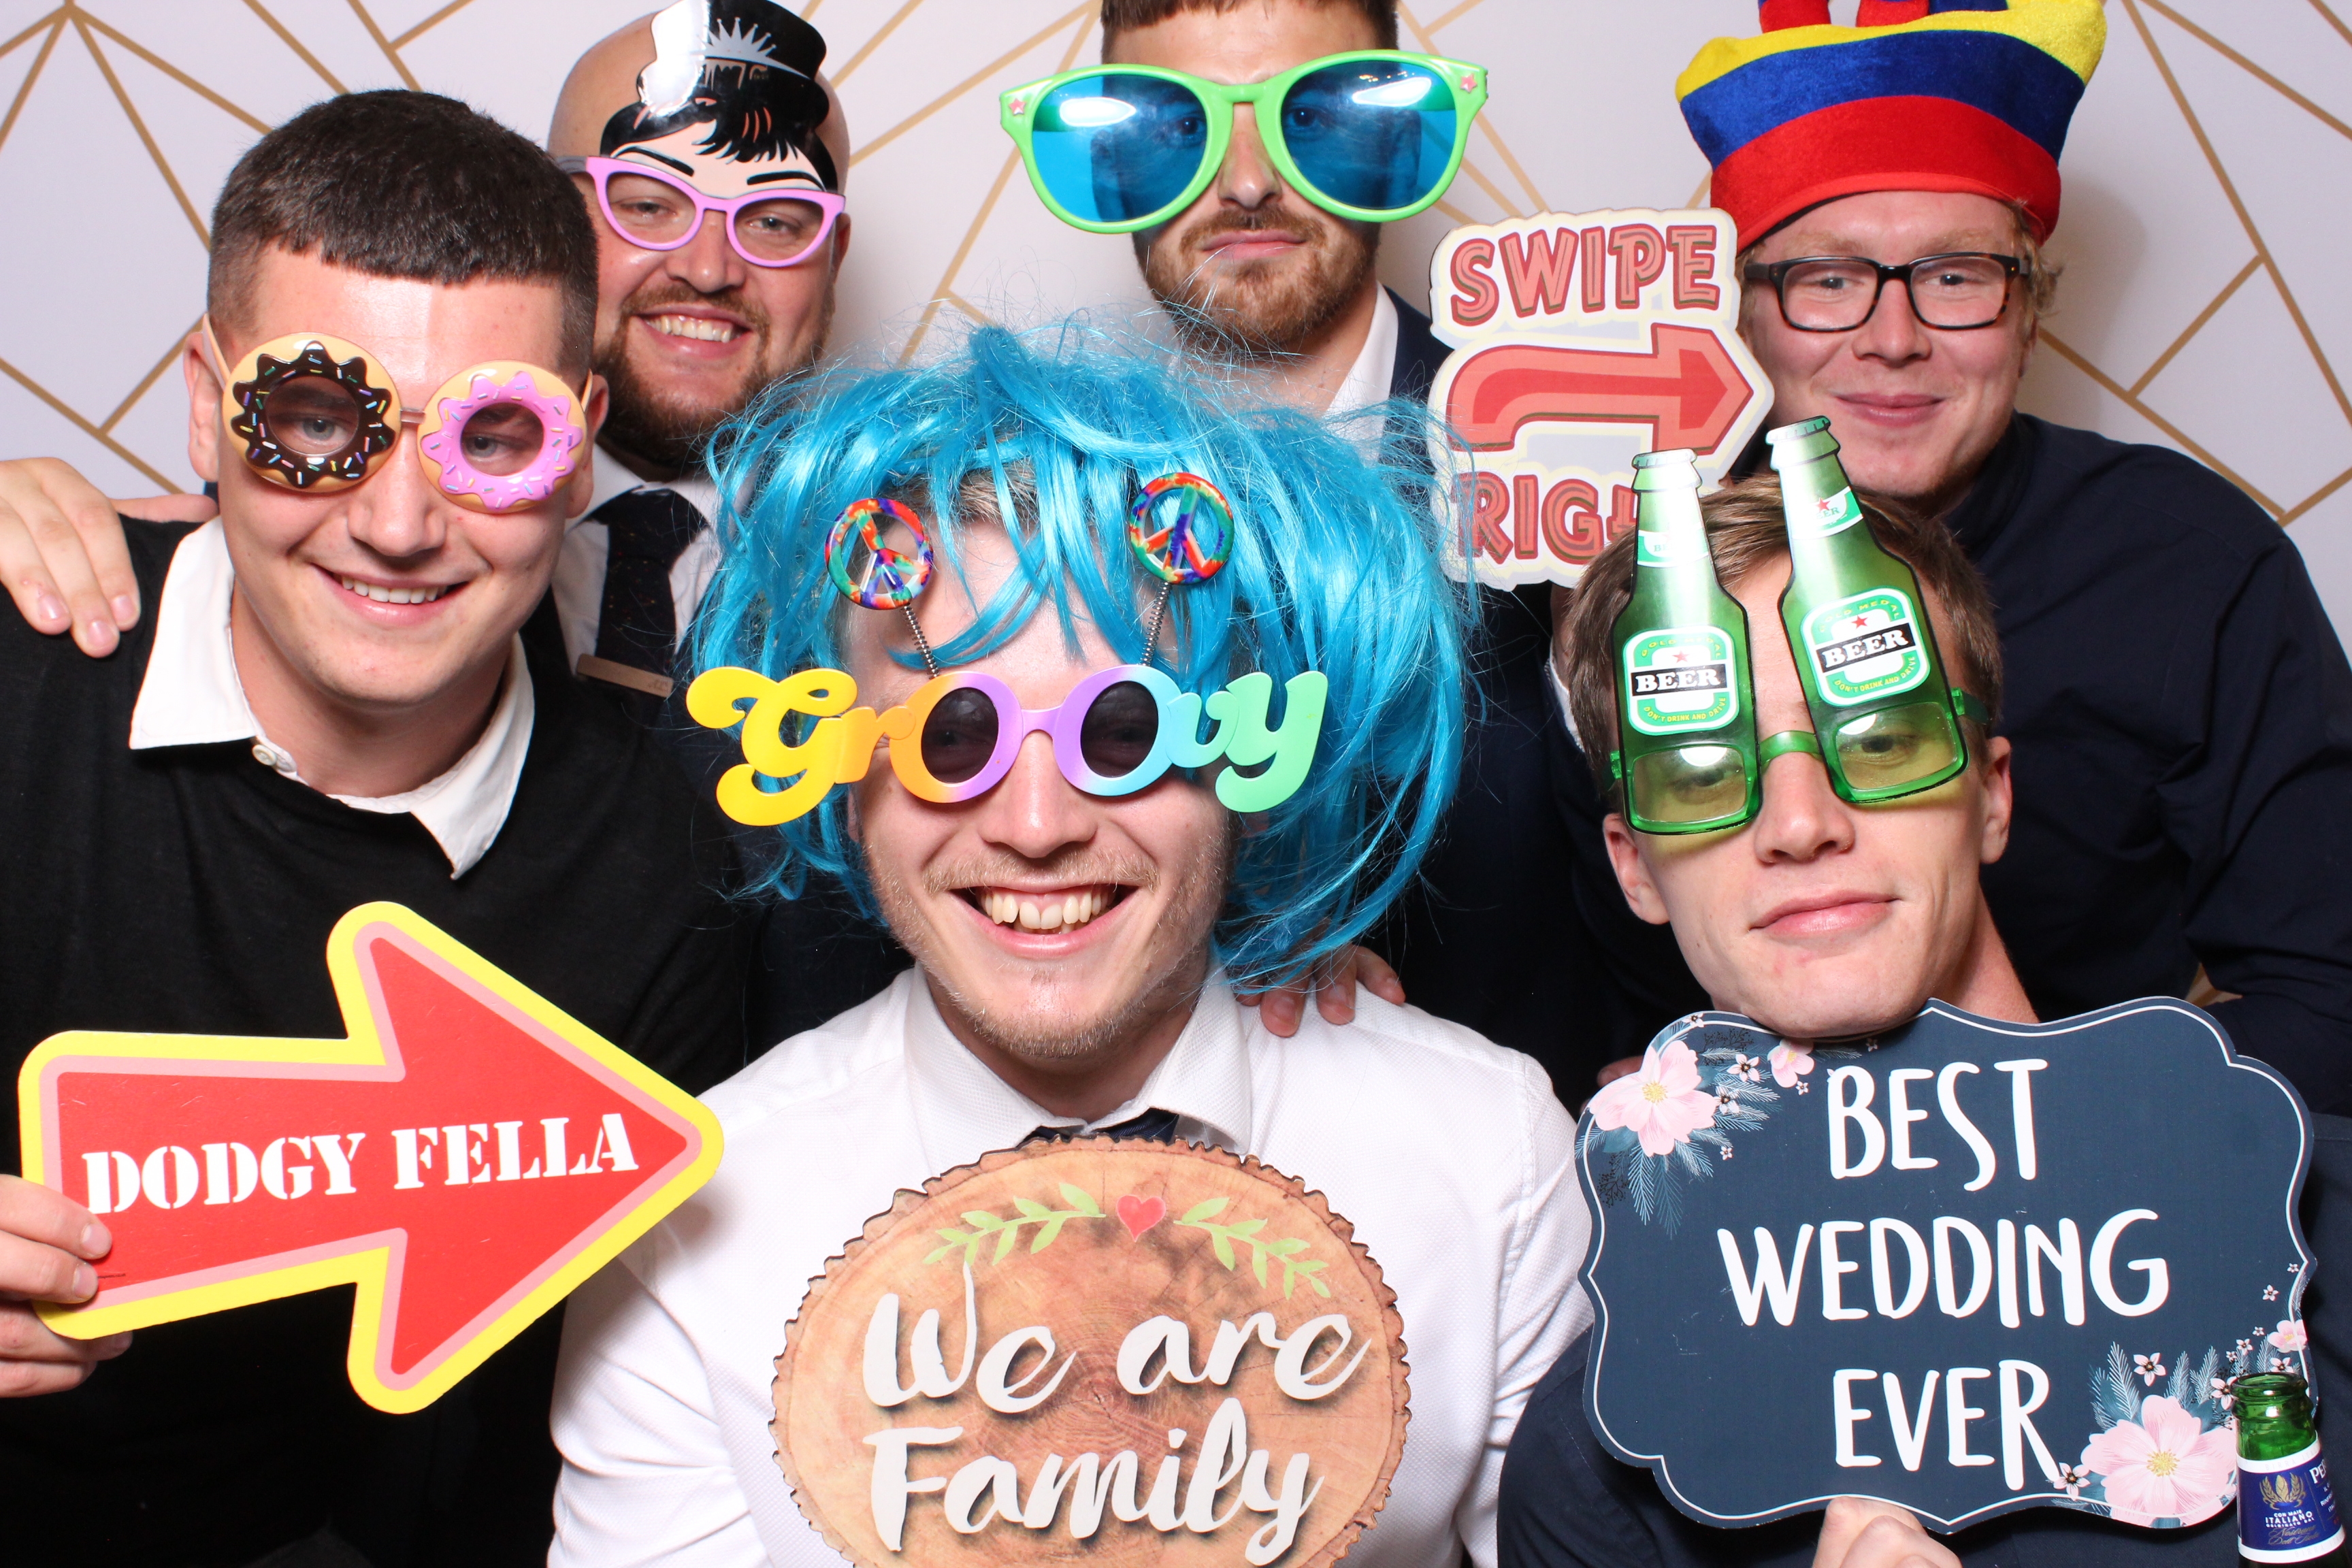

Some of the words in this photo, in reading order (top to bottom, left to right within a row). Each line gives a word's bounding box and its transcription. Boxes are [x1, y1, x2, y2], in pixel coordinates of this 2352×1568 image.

[1450, 223, 1720, 326] SWIPE
[1450, 471, 1636, 565] RIG
[1641, 639, 1677, 657] GOLD
[1818, 609, 1852, 634] GOLD
[1859, 599, 1901, 619] MEDAL
[1822, 630, 1909, 668] BEER
[1635, 668, 1721, 693] BEER
[1643, 706, 1666, 722] DON'T
[1667, 714, 1690, 723] DRINK
[1692, 713, 1707, 721] AND
[1709, 697, 1727, 717] DRIVE
[1833, 679, 1859, 693] DON'T
[1860, 680, 1884, 692] DRINK
[1884, 676, 1901, 685] AND
[1900, 656, 1916, 679] DRIVE
[82, 1131, 365, 1214] DODGY
[391, 1113, 639, 1191] FELLA
[1829, 1058, 2048, 1192] BEST
[1717, 1209, 2170, 1329] WEDDING
[862, 1261, 1077, 1414] We
[1116, 1312, 1372, 1401] are
[1833, 1360, 2060, 1490] EVER
[862, 1397, 1325, 1567] Family
[2265, 1510, 2313, 1524] ITALIANO
